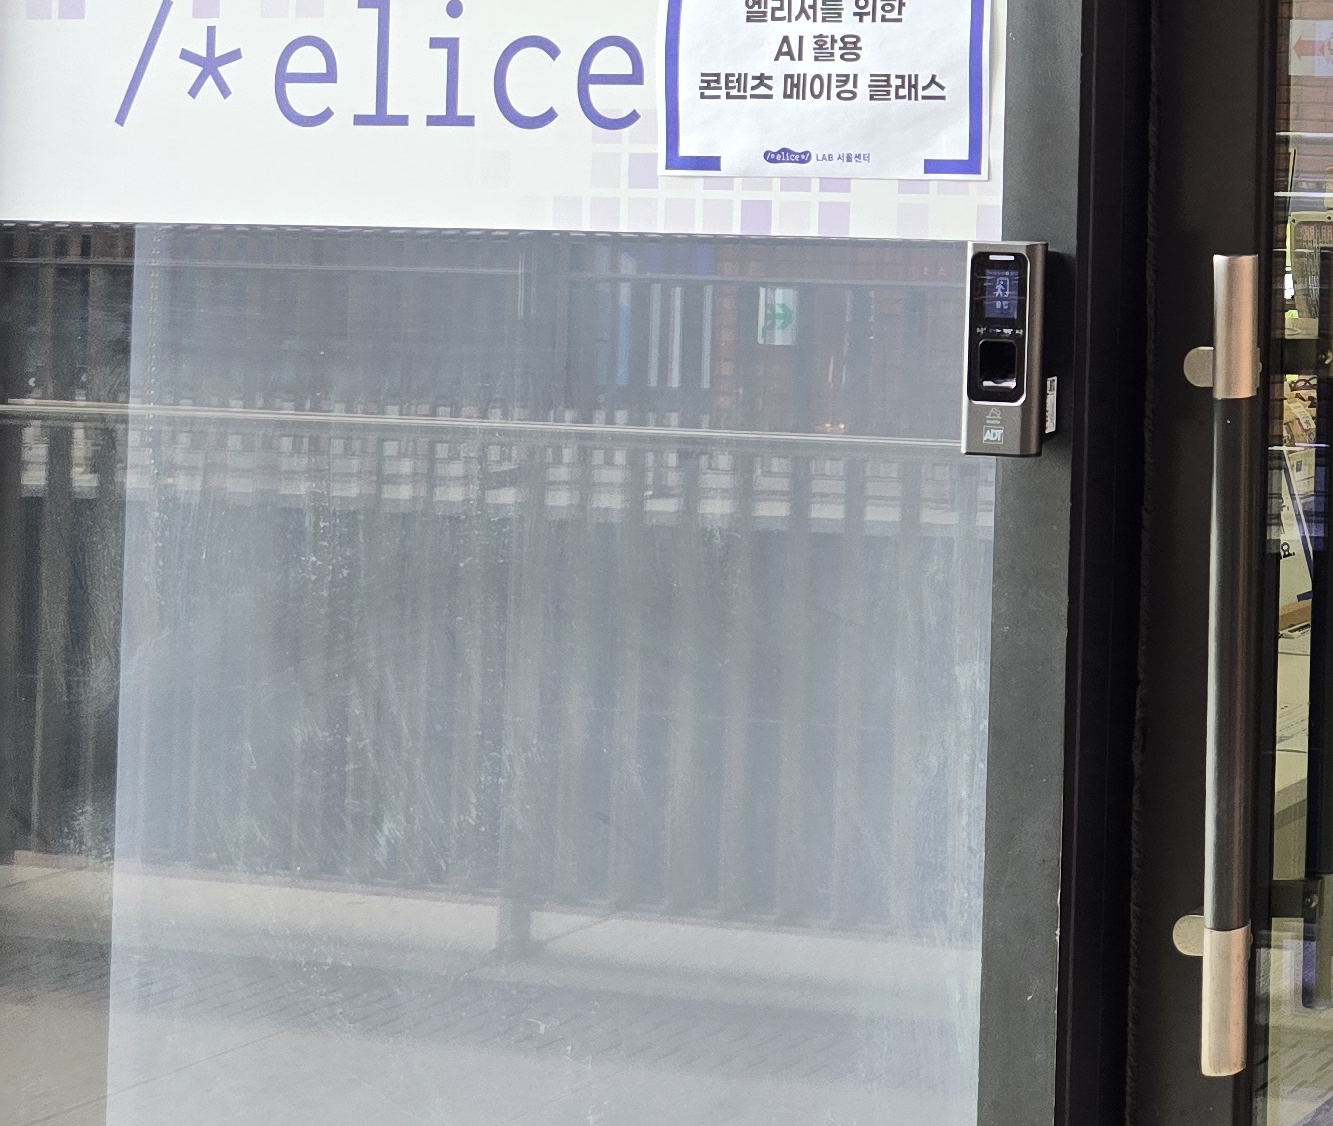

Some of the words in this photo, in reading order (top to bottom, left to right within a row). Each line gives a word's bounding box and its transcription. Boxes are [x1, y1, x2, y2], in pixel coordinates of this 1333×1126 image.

[774, 36, 803, 61] AI
[813, 34, 862, 62] 활용
[699, 73, 773, 99] 콘텐츠
[783, 73, 858, 101] 메이킹
[868, 74, 946, 101] 클래스
[984, 429, 1003, 441] ADT
